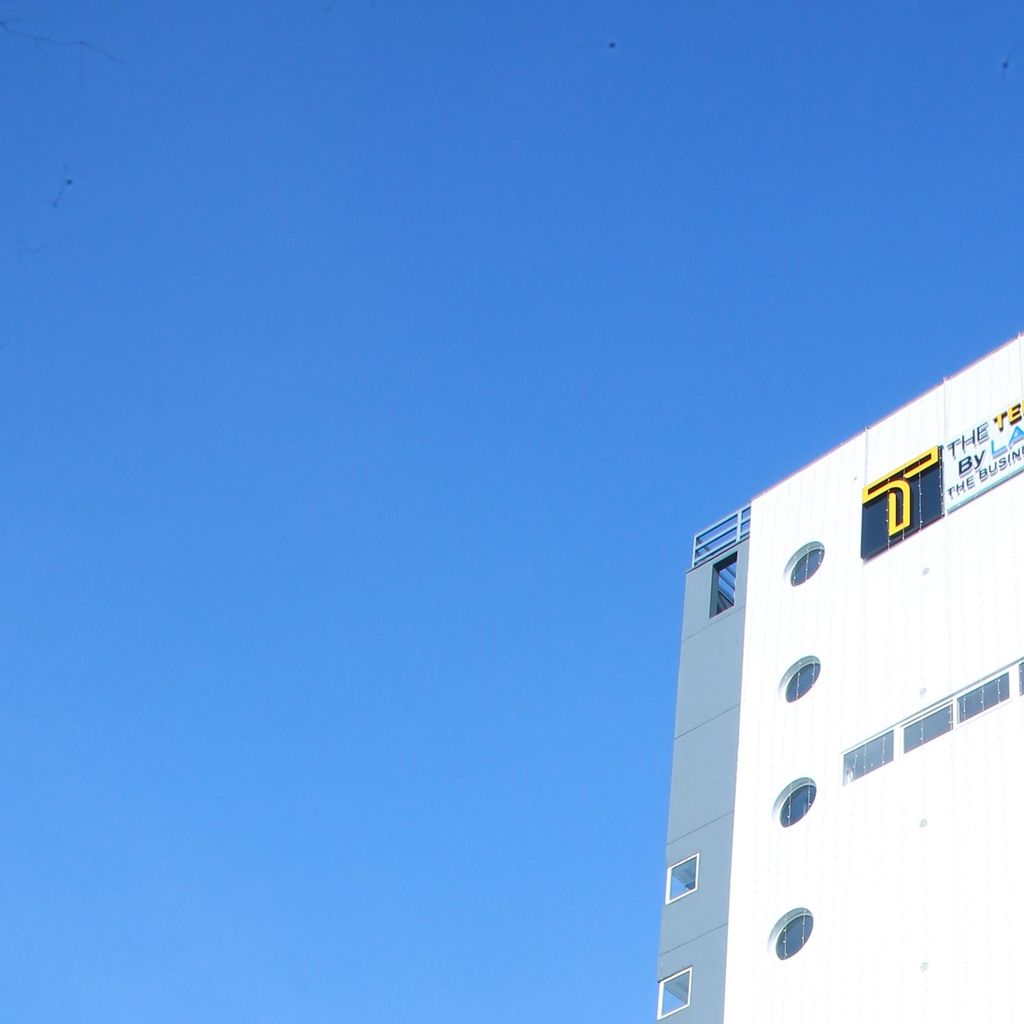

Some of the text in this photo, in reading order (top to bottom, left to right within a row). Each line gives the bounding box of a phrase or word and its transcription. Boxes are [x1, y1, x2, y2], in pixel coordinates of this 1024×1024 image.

[946, 422, 989, 460] THE
[958, 450, 986, 475] By
[947, 478, 975, 500] THE
